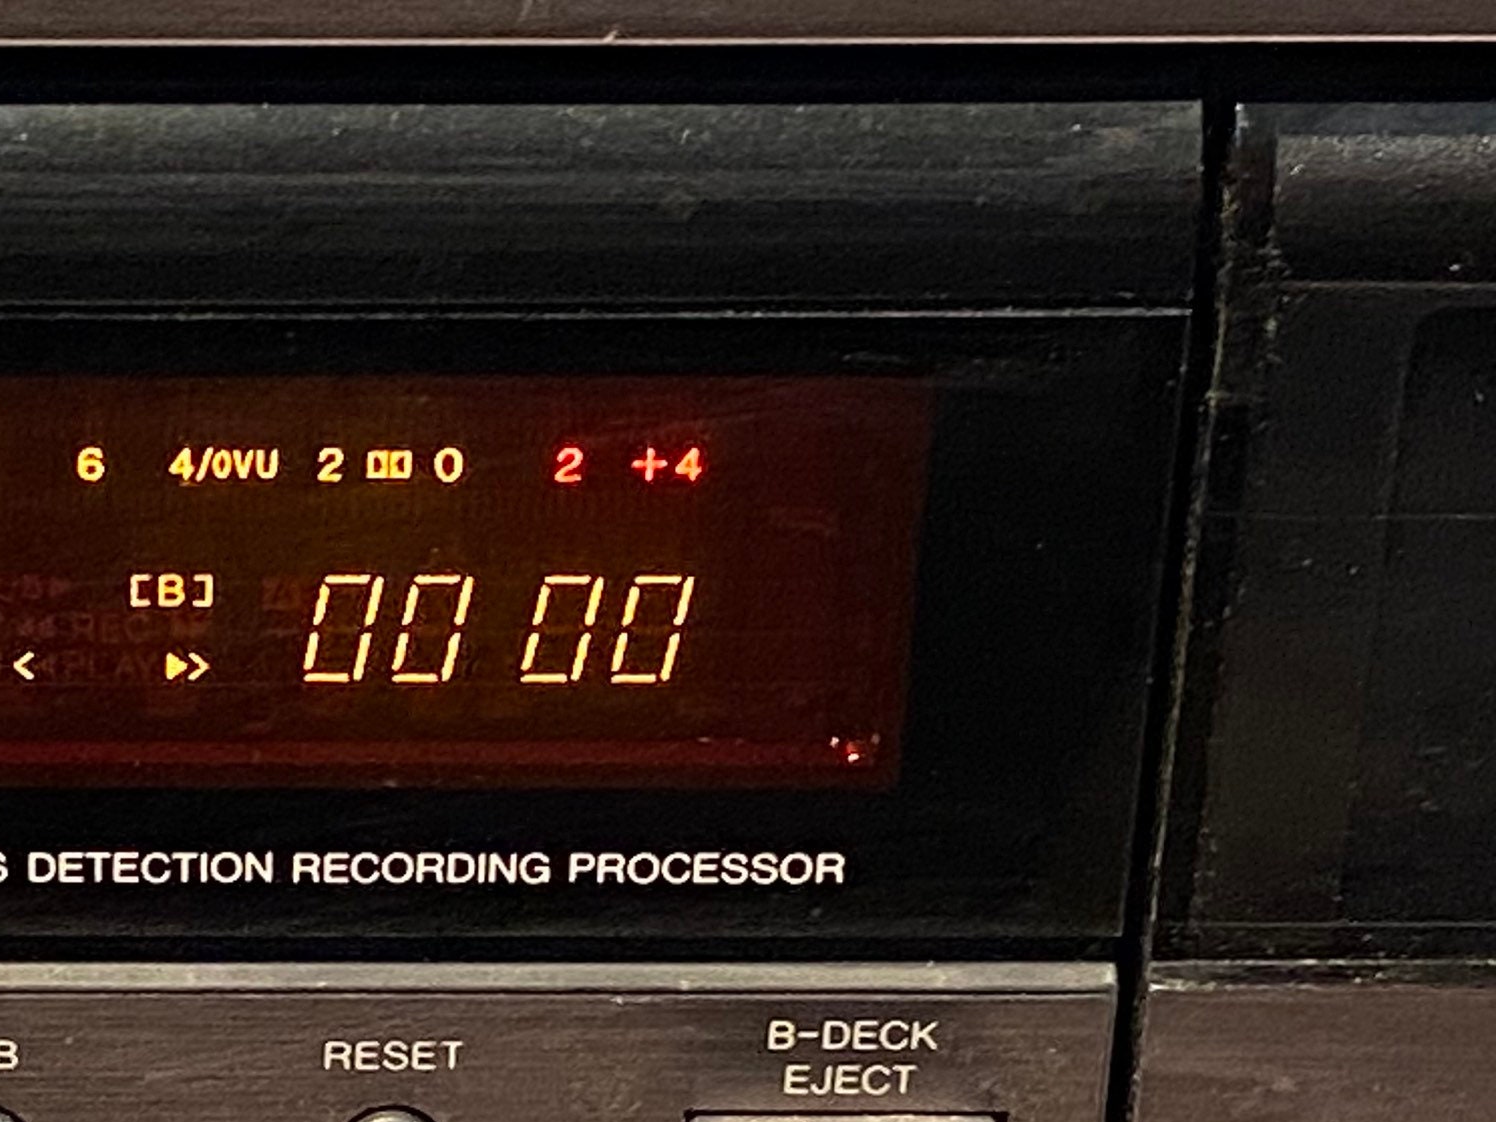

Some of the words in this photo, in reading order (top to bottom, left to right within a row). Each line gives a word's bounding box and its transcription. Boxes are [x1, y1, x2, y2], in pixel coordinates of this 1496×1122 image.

[76, 446, 105, 482] 6
[317, 447, 345, 483] 2
[554, 447, 584, 483] 2
[631, 447, 703, 483] +4
[302, 574, 475, 683] 00
[520, 574, 695, 684] 00
[27, 851, 274, 884] DETECTION
[292, 851, 551, 885] RECORDING
[568, 851, 846, 885] PROCESSOR
[768, 1020, 938, 1051] B-DECK
[324, 1040, 463, 1071] RESET
[783, 1064, 917, 1096] EJECT
